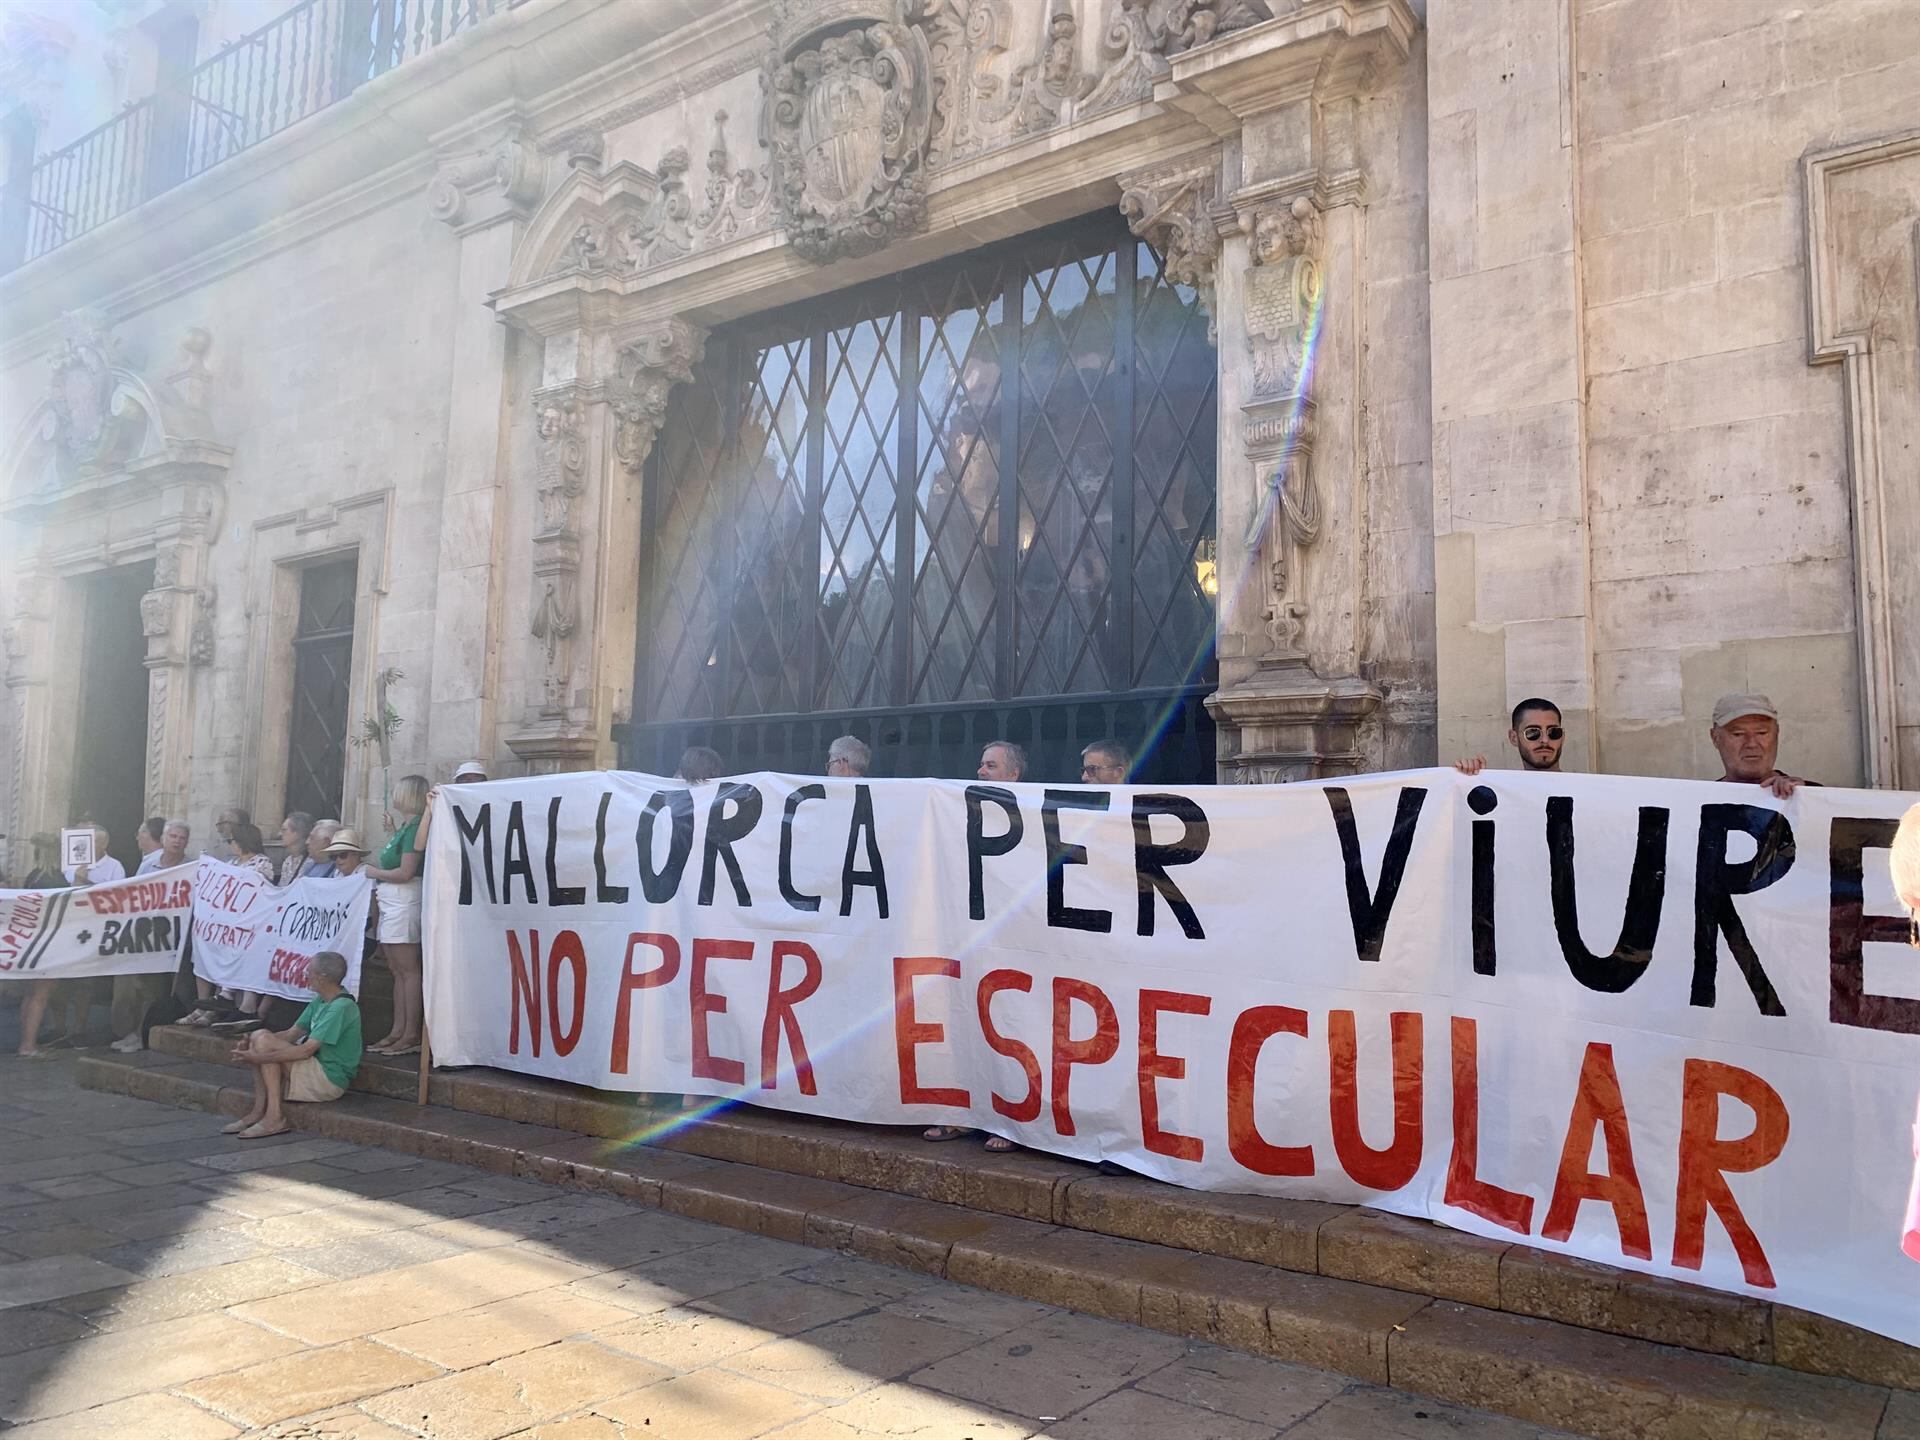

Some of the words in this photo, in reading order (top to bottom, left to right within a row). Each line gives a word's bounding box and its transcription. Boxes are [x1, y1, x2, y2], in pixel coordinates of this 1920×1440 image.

[99, 916, 181, 956] BARRI
[453, 782, 889, 919] MALLORCA
[966, 785, 1210, 939] PER
[506, 928, 586, 1058] NO
[610, 932, 822, 1096] PER
[893, 956, 1790, 1288] ESPECULAR
